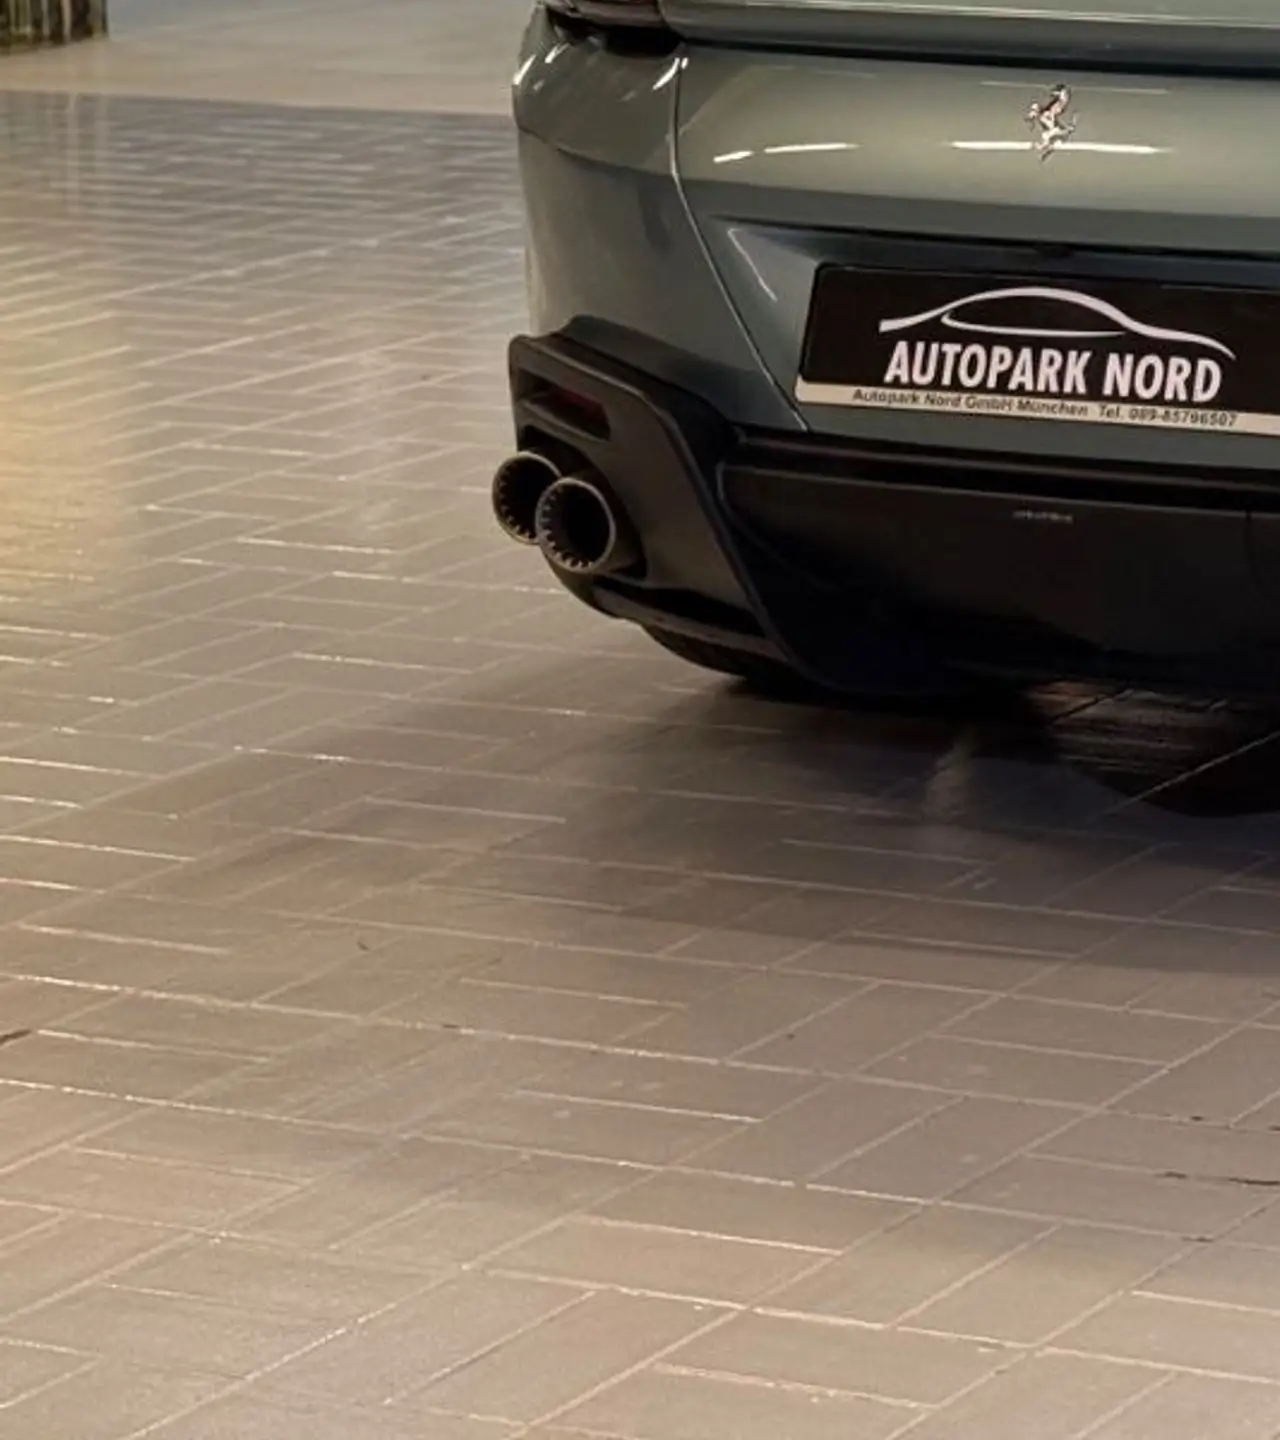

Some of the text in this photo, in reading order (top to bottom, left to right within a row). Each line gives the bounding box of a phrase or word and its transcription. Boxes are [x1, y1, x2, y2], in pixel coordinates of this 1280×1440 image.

[884, 340, 1222, 402] AUTOPARK NORD
[852, 389, 918, 405] Autopark
[924, 394, 961, 407] Nord
[965, 396, 1013, 411] GmbH
